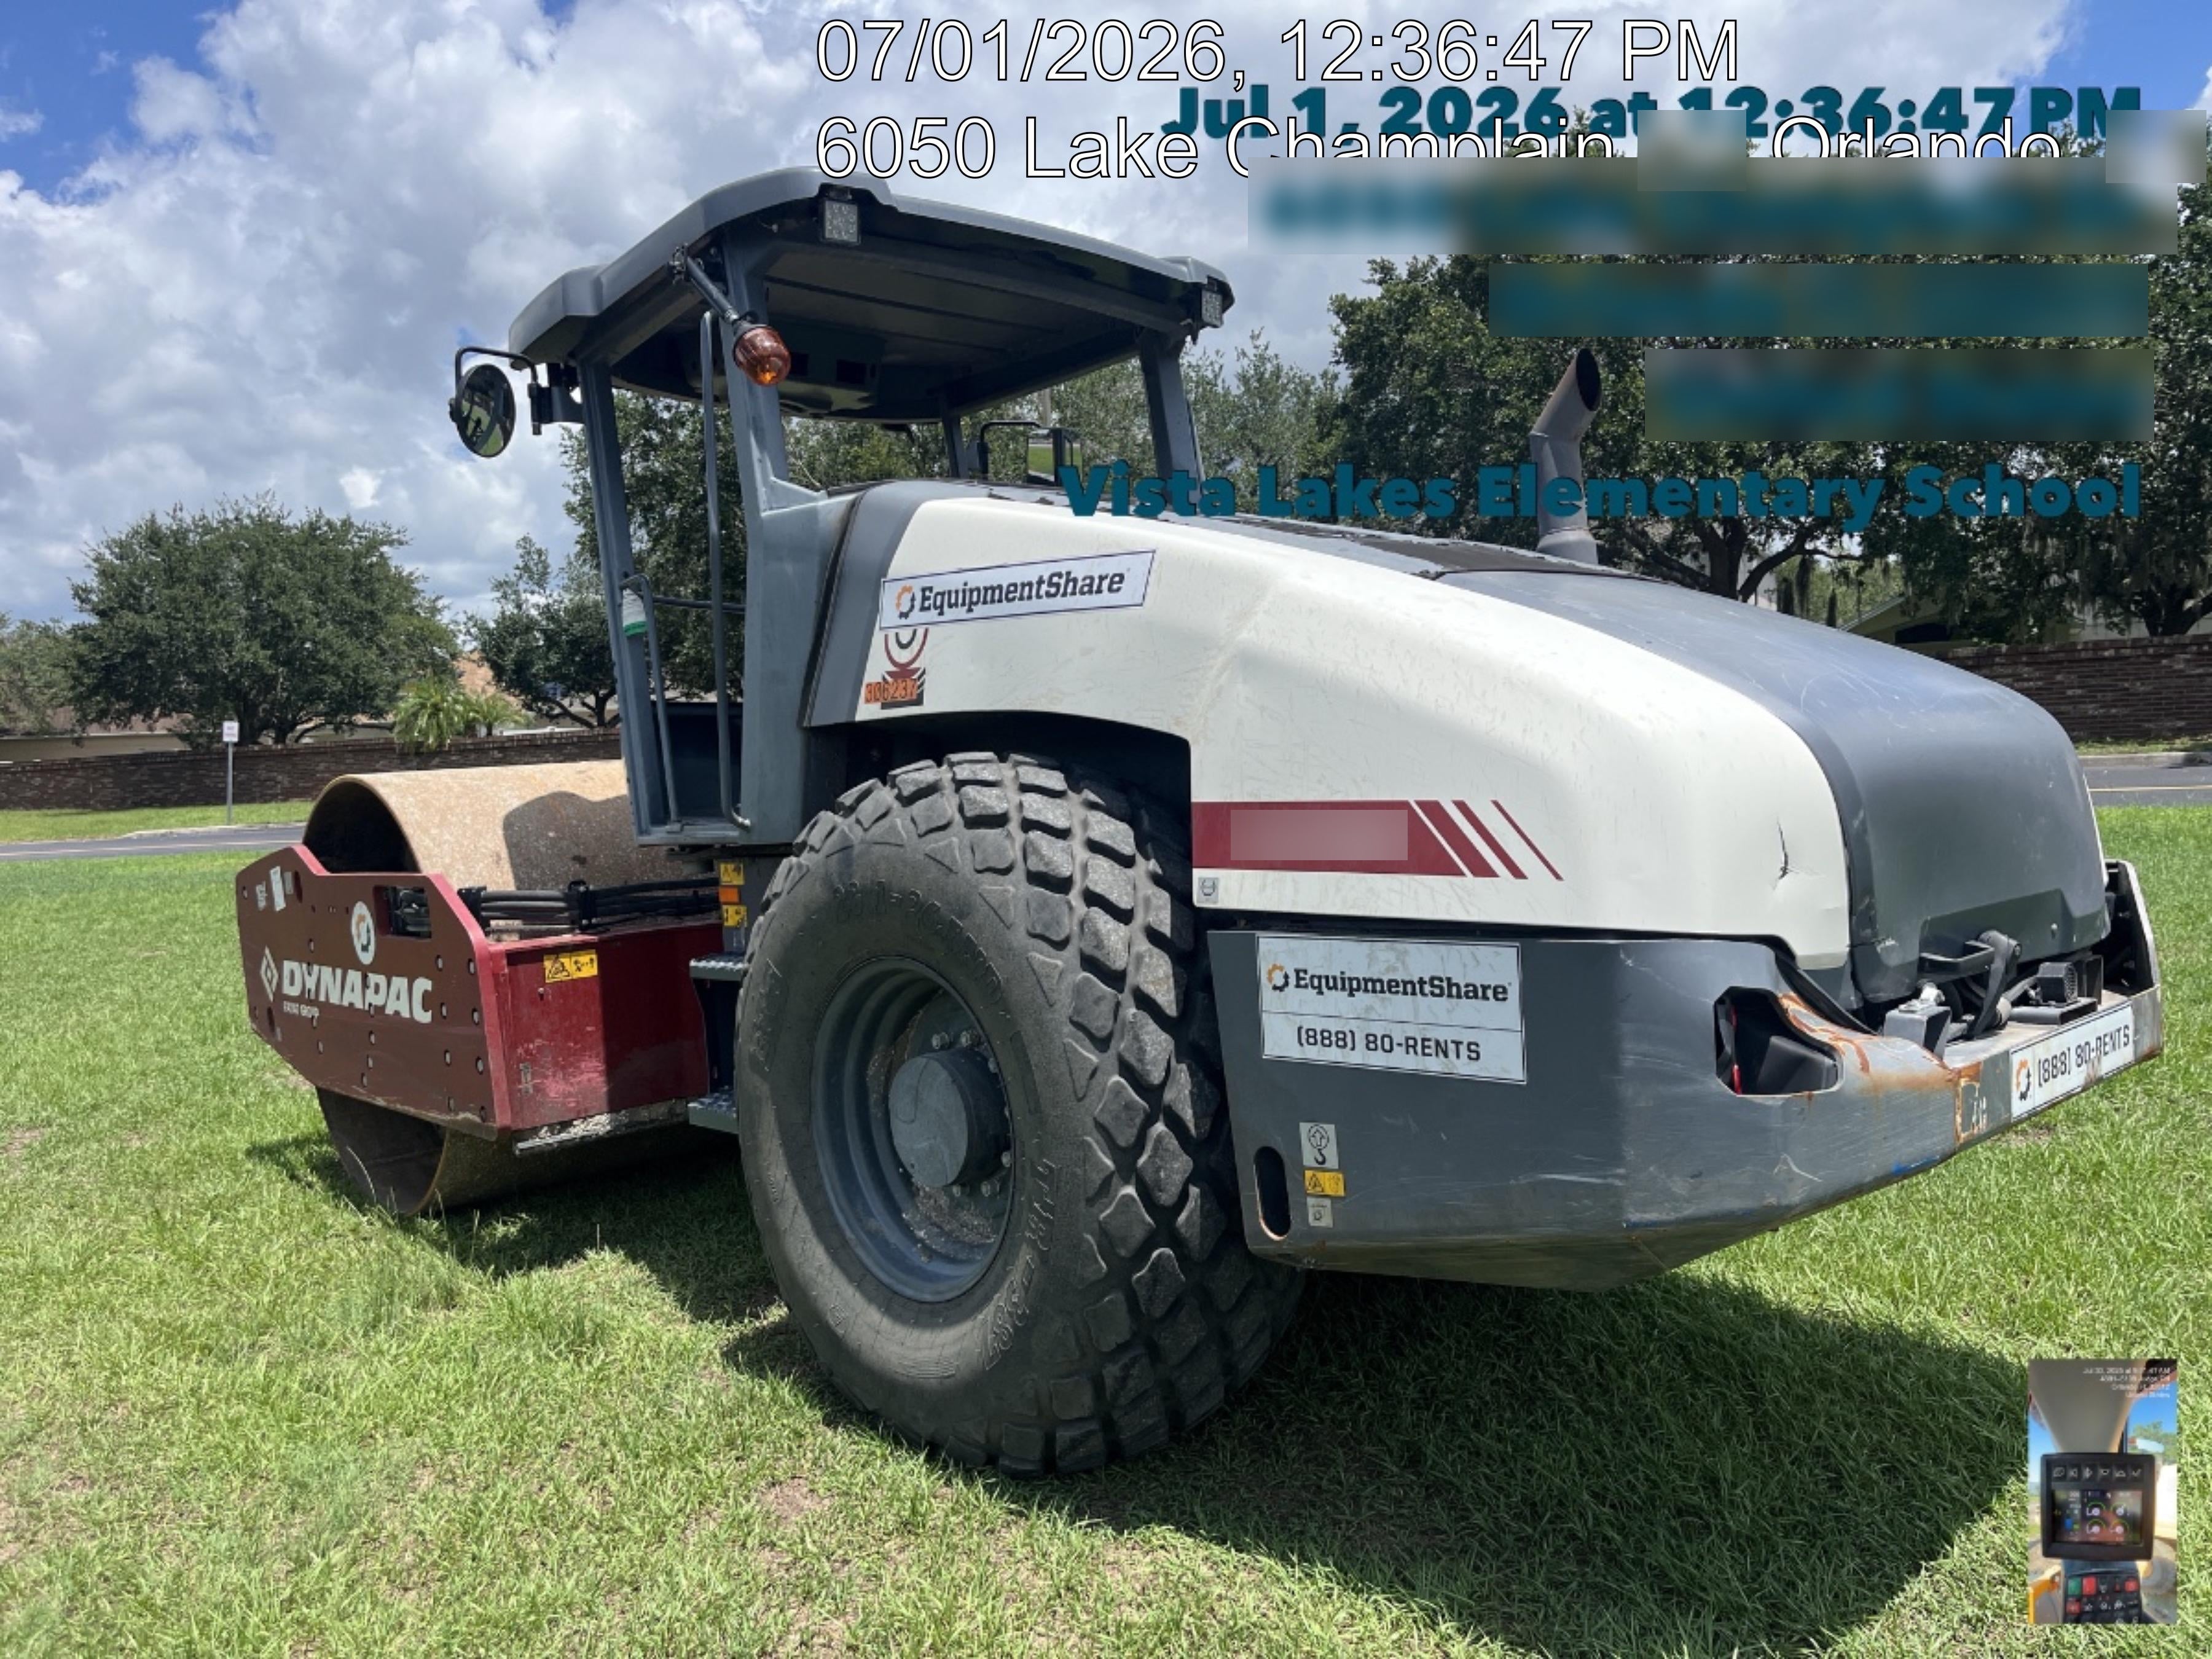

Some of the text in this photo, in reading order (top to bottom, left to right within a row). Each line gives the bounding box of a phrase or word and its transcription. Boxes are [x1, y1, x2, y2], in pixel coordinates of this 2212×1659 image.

[918, 571, 1125, 616] EquipmentShare
[282, 959, 433, 1024] DYNAPAC
[1293, 968, 1509, 1002] EquipmentShare
[1297, 1026, 1481, 1062] (888) 80-RENTS
